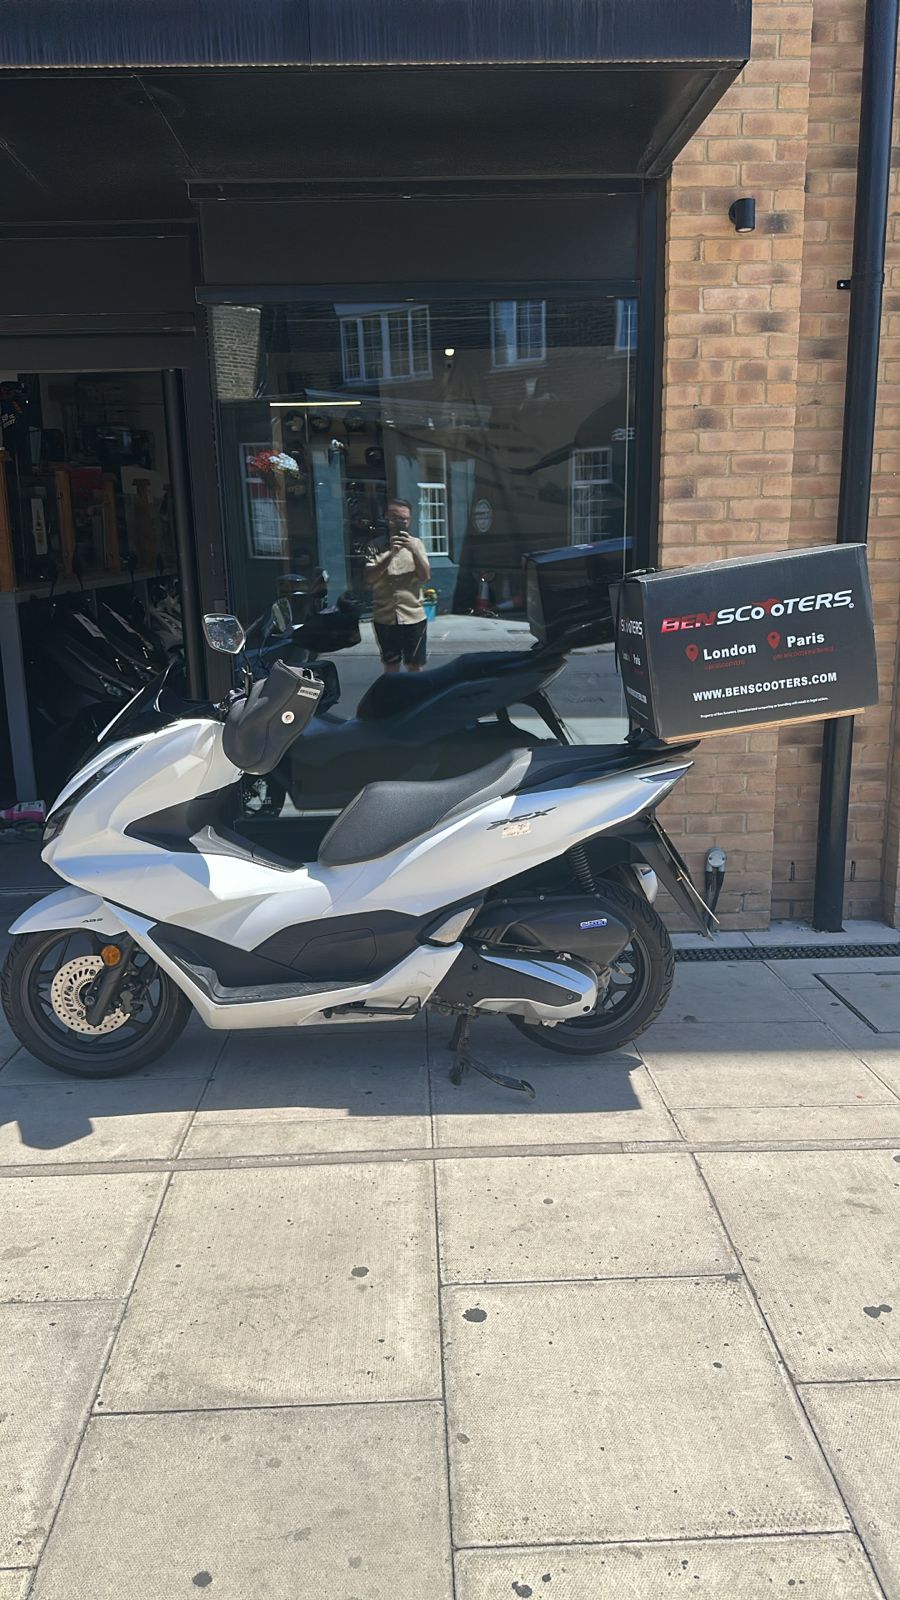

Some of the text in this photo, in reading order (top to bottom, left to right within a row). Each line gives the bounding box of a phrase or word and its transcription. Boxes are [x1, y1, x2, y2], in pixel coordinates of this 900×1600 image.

[786, 631, 825, 648] Paris
[703, 643, 757, 660] London
[693, 672, 838, 702] WWW.BENSCOOTERS.COM
